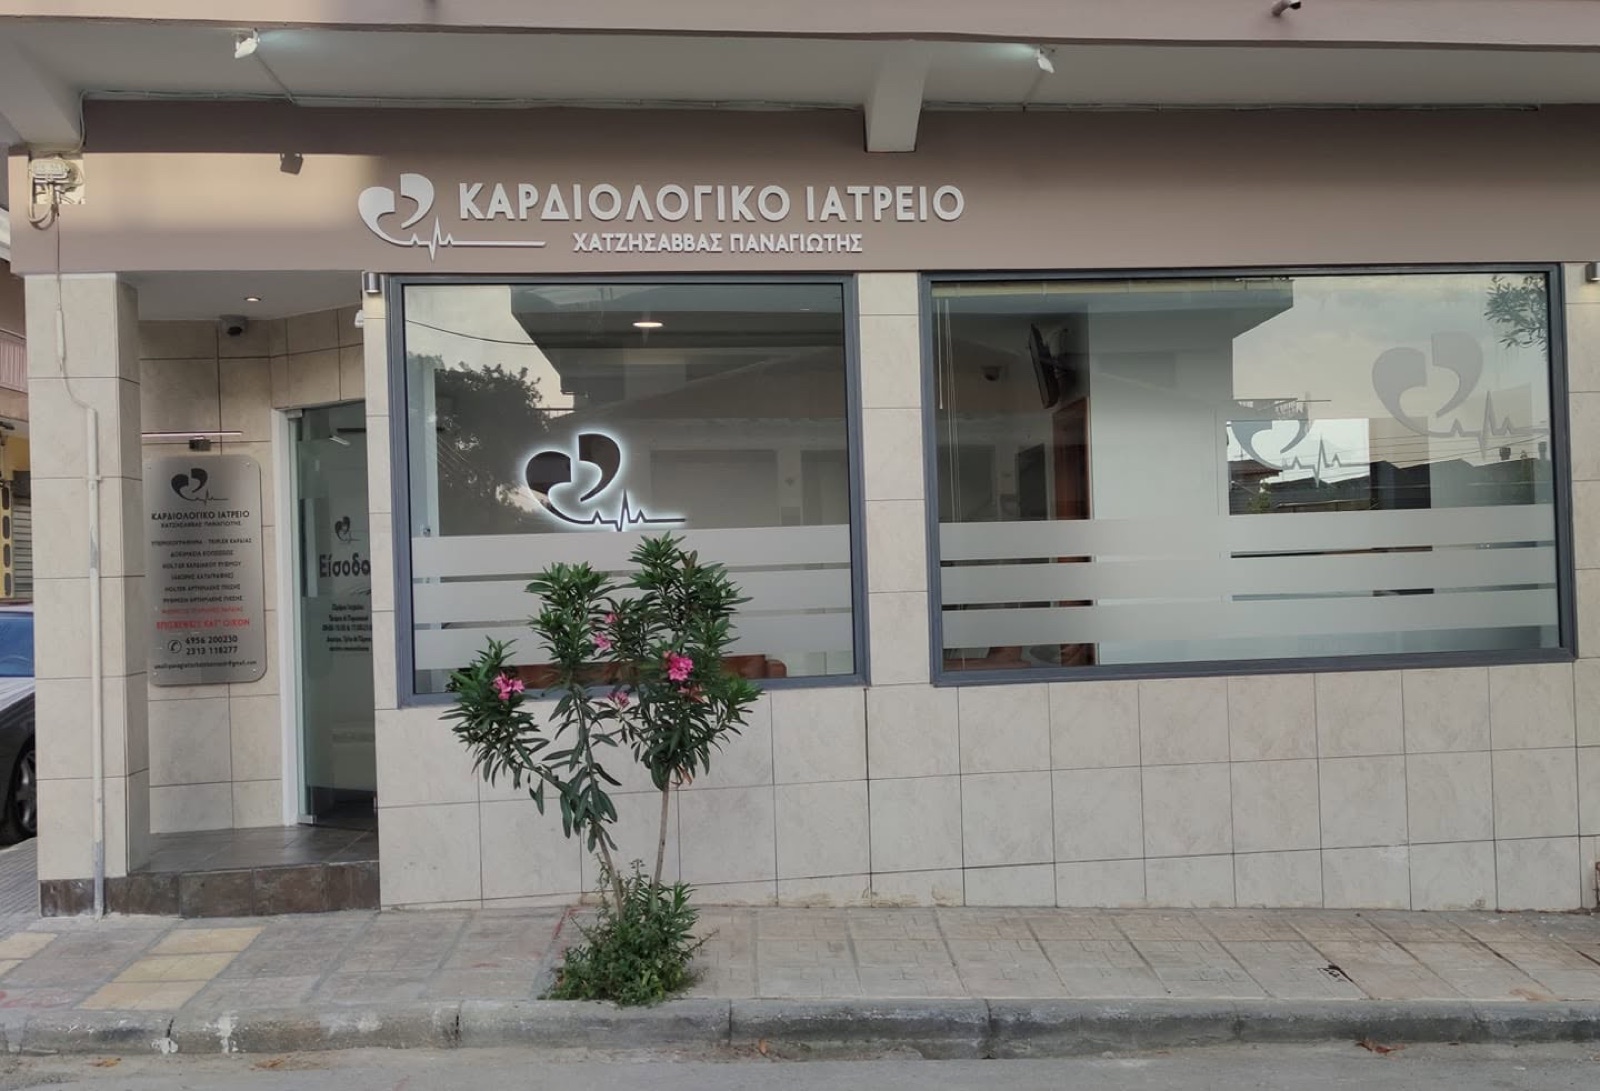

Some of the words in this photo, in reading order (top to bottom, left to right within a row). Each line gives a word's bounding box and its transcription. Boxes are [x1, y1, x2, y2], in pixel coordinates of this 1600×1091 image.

[459, 182, 791, 222] ΚΑΡΔΙΟΛΟΓΙΚΟ
[806, 184, 965, 222] ΙΑΤΡΕΙΟ
[573, 232, 723, 253] ΧΑΤΖΗΣΑΒΒΑΣ
[729, 233, 863, 253] ΠΑΝΑΓΙΩΤΗΣ
[151, 511, 216, 520] ΚΑΡΔΙΟΛΟΓΙΚΟ
[217, 510, 250, 518] ΙΑΤΡΕΙΟ
[319, 553, 371, 578] Είσοδο
